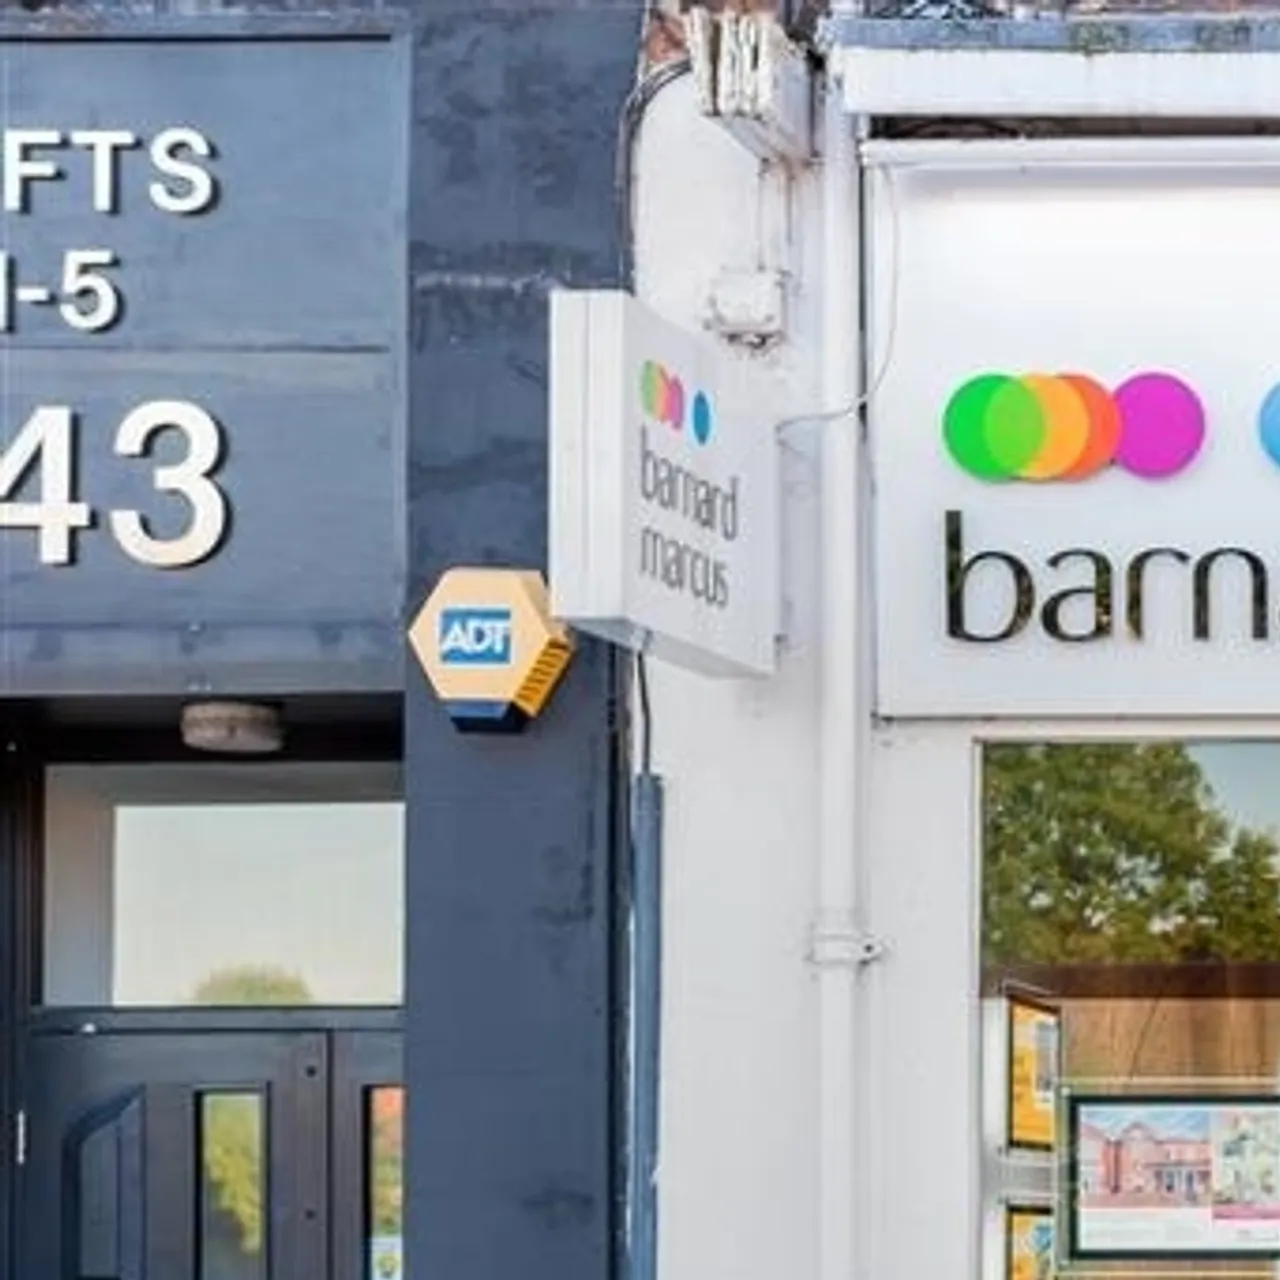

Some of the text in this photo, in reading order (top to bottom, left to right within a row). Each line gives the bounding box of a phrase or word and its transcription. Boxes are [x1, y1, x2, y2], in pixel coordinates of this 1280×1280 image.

[4, 127, 214, 213] FTS
[0, 400, 225, 566] 43
[640, 424, 738, 541] barnard
[639, 526, 729, 609] marcus
[441, 618, 511, 653] ADT
